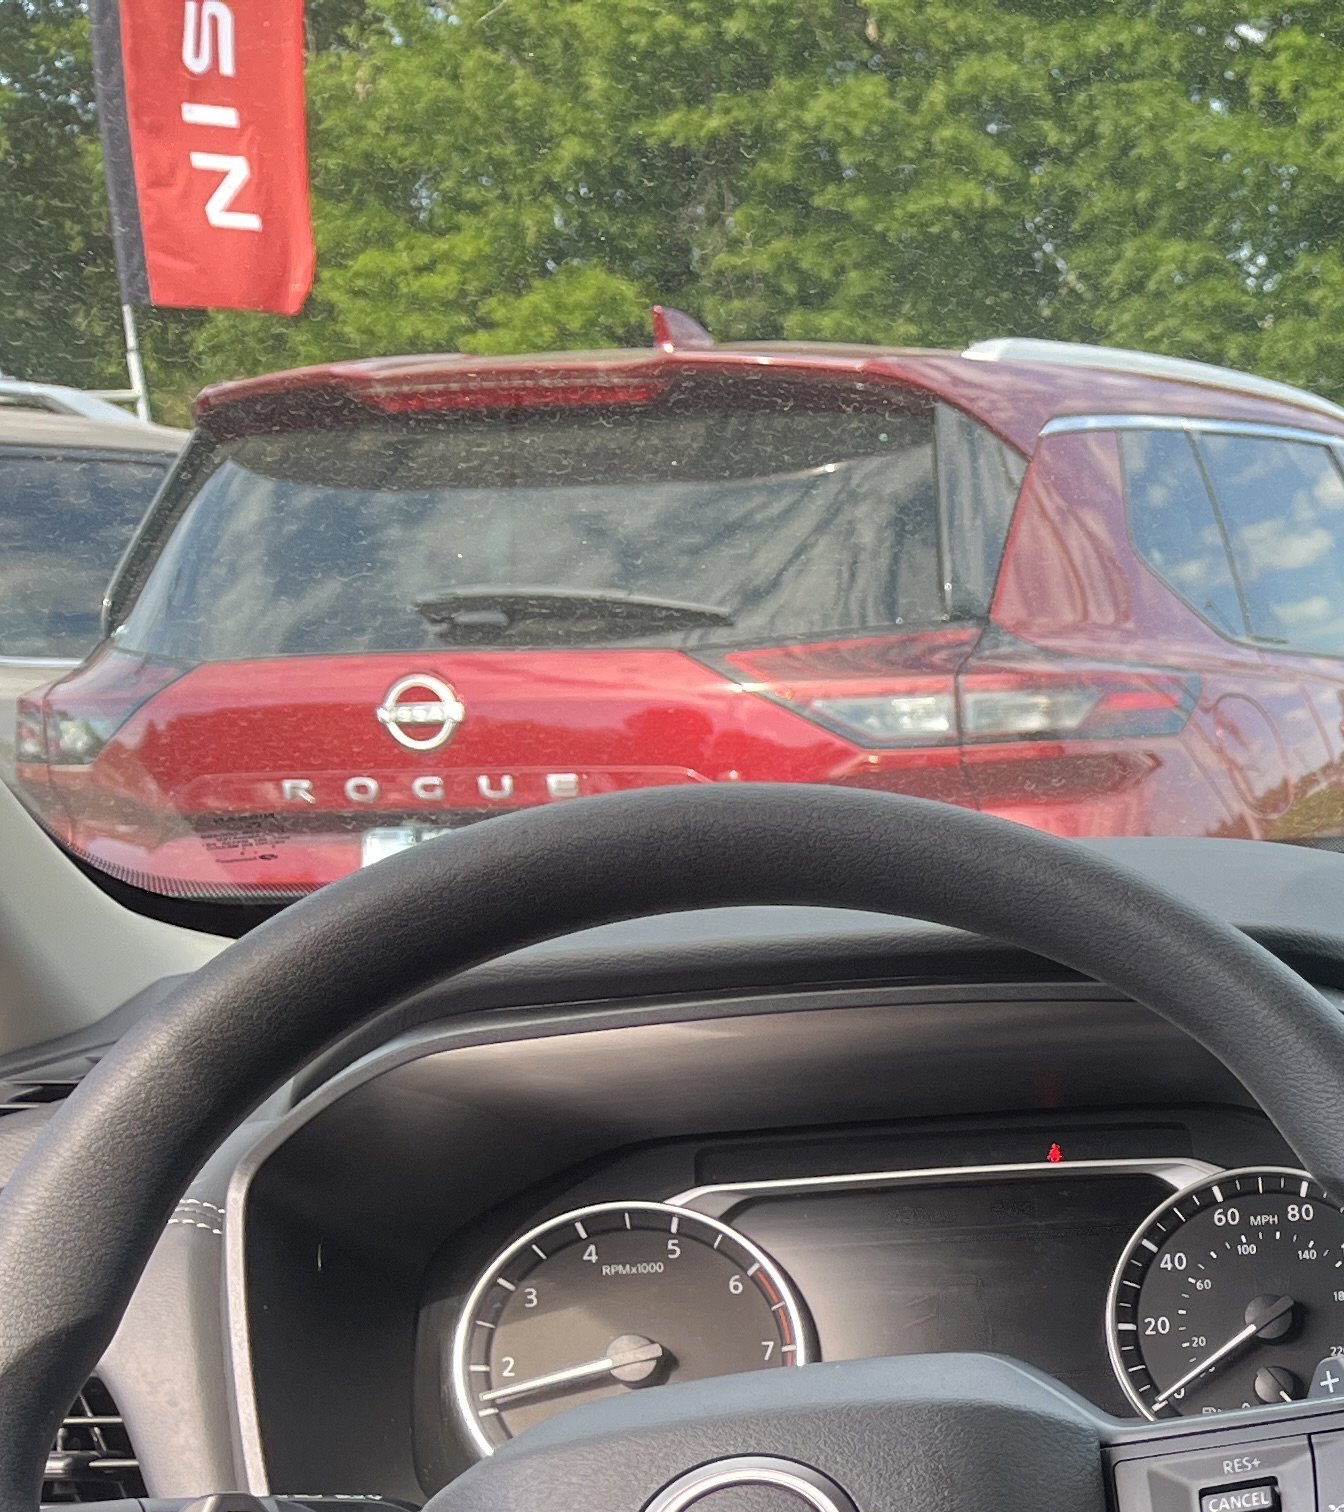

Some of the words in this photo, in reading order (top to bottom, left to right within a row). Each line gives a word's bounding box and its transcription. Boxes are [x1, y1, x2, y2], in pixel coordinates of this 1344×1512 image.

[281, 772, 579, 803] ROGUE
[1213, 1208, 1240, 1226] 60
[1250, 1214, 1278, 1226] MPH
[1287, 1204, 1314, 1222] 80
[582, 1244, 598, 1263] 4
[666, 1240, 681, 1258] 5
[1236, 1244, 1257, 1256] 100
[1297, 1250, 1318, 1261] 140
[601, 1262, 664, 1276] RPMx1000
[1160, 1252, 1187, 1271] 40
[728, 1276, 743, 1294] 6
[1195, 1279, 1212, 1290] 60
[524, 1289, 538, 1308] 3
[1144, 1316, 1170, 1335] 20
[761, 1342, 774, 1360] 7
[1192, 1336, 1207, 1348] 20
[502, 1357, 516, 1376] 2
[1222, 1458, 1261, 1474] RES+
[1208, 1492, 1269, 1512] CANCEL
